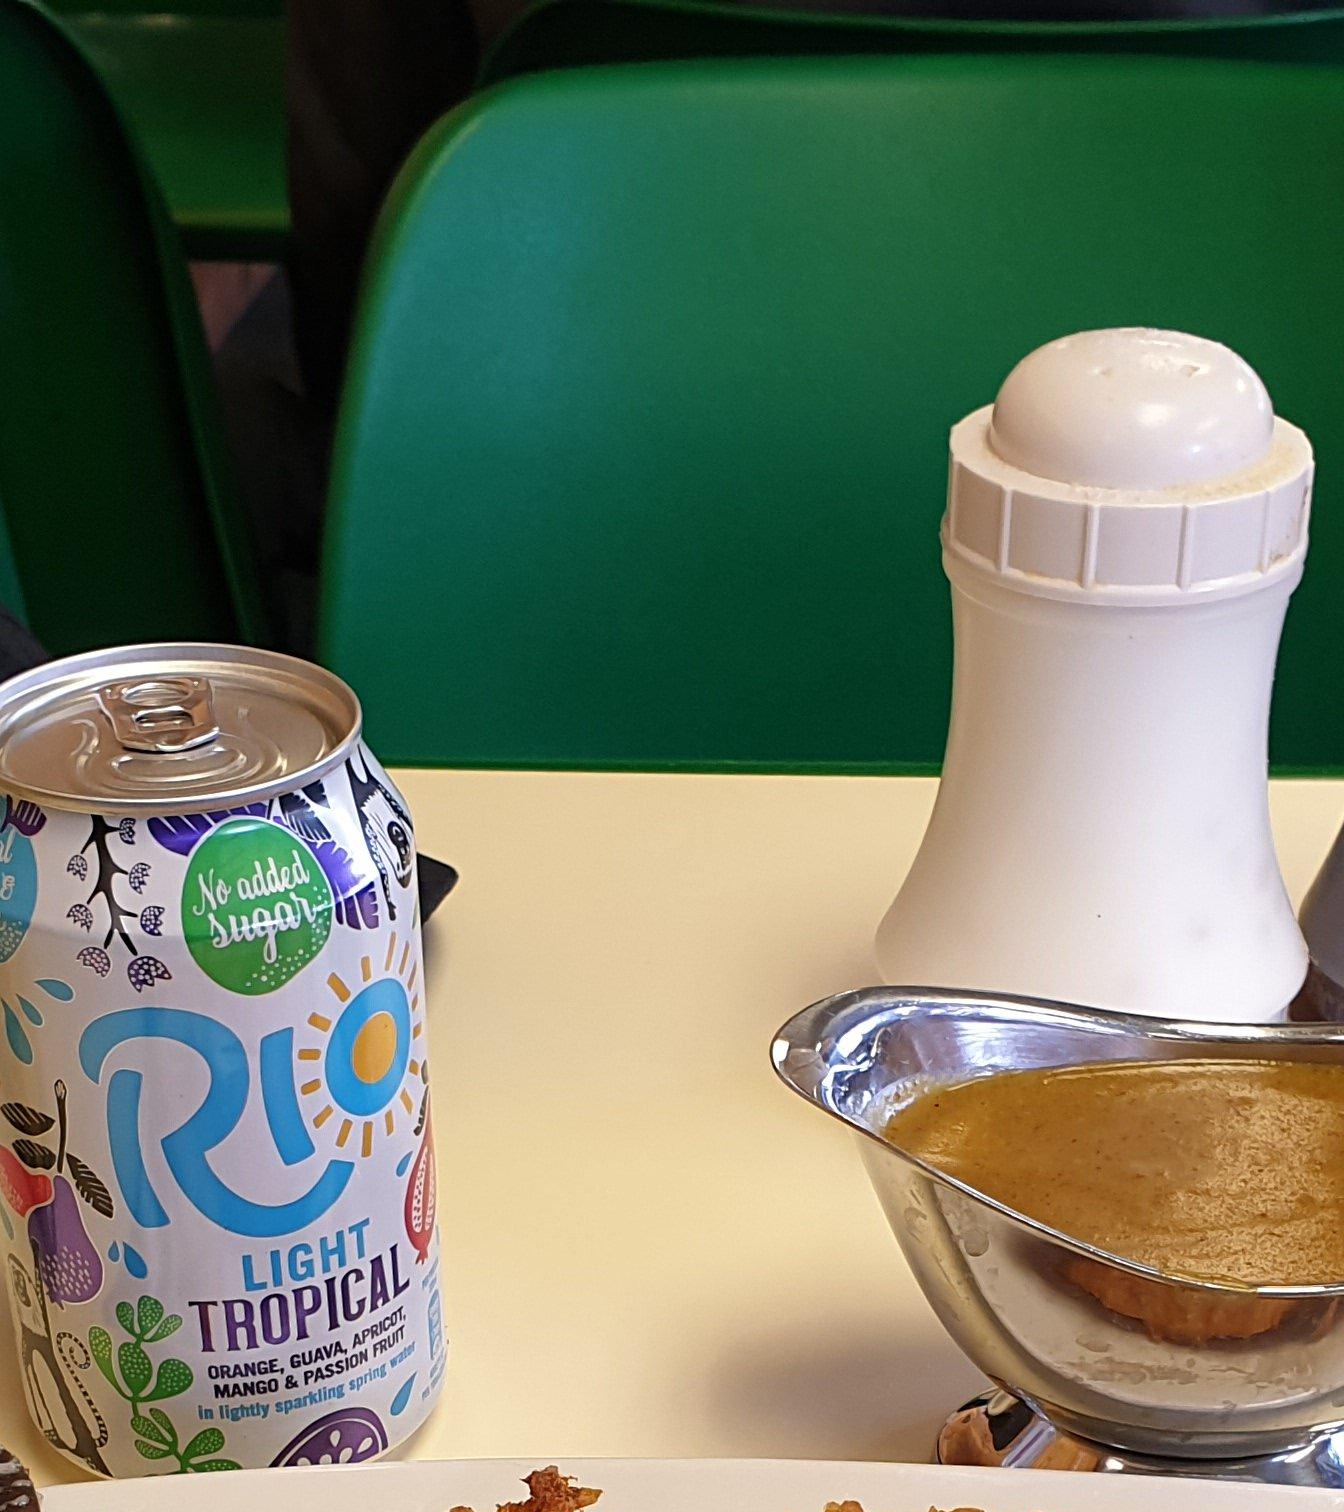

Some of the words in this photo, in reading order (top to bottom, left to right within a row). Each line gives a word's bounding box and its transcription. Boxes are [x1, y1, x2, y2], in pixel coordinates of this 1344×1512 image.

[0, 873, 16, 900] &
[192, 867, 232, 916] No
[237, 850, 311, 900] added
[207, 892, 317, 964] sugar
[79, 1007, 411, 1238] RIO
[242, 1217, 372, 1292] LIGHT
[189, 1244, 411, 1353] TROPICAL
[207, 1358, 285, 1380] ORANGE,
[290, 1341, 348, 1368] GUAVA,
[352, 1305, 407, 1349] APRICOT,
[214, 1379, 279, 1399] MANGO
[285, 1375, 299, 1389] &
[304, 1348, 368, 1385] PASSION
[373, 1325, 406, 1358] FRUIT
[198, 1405, 214, 1420] in
[219, 1402, 270, 1421] lightly
[275, 1381, 345, 1413] sparkling
[349, 1362, 387, 1391] spring
[390, 1341, 416, 1368] water
